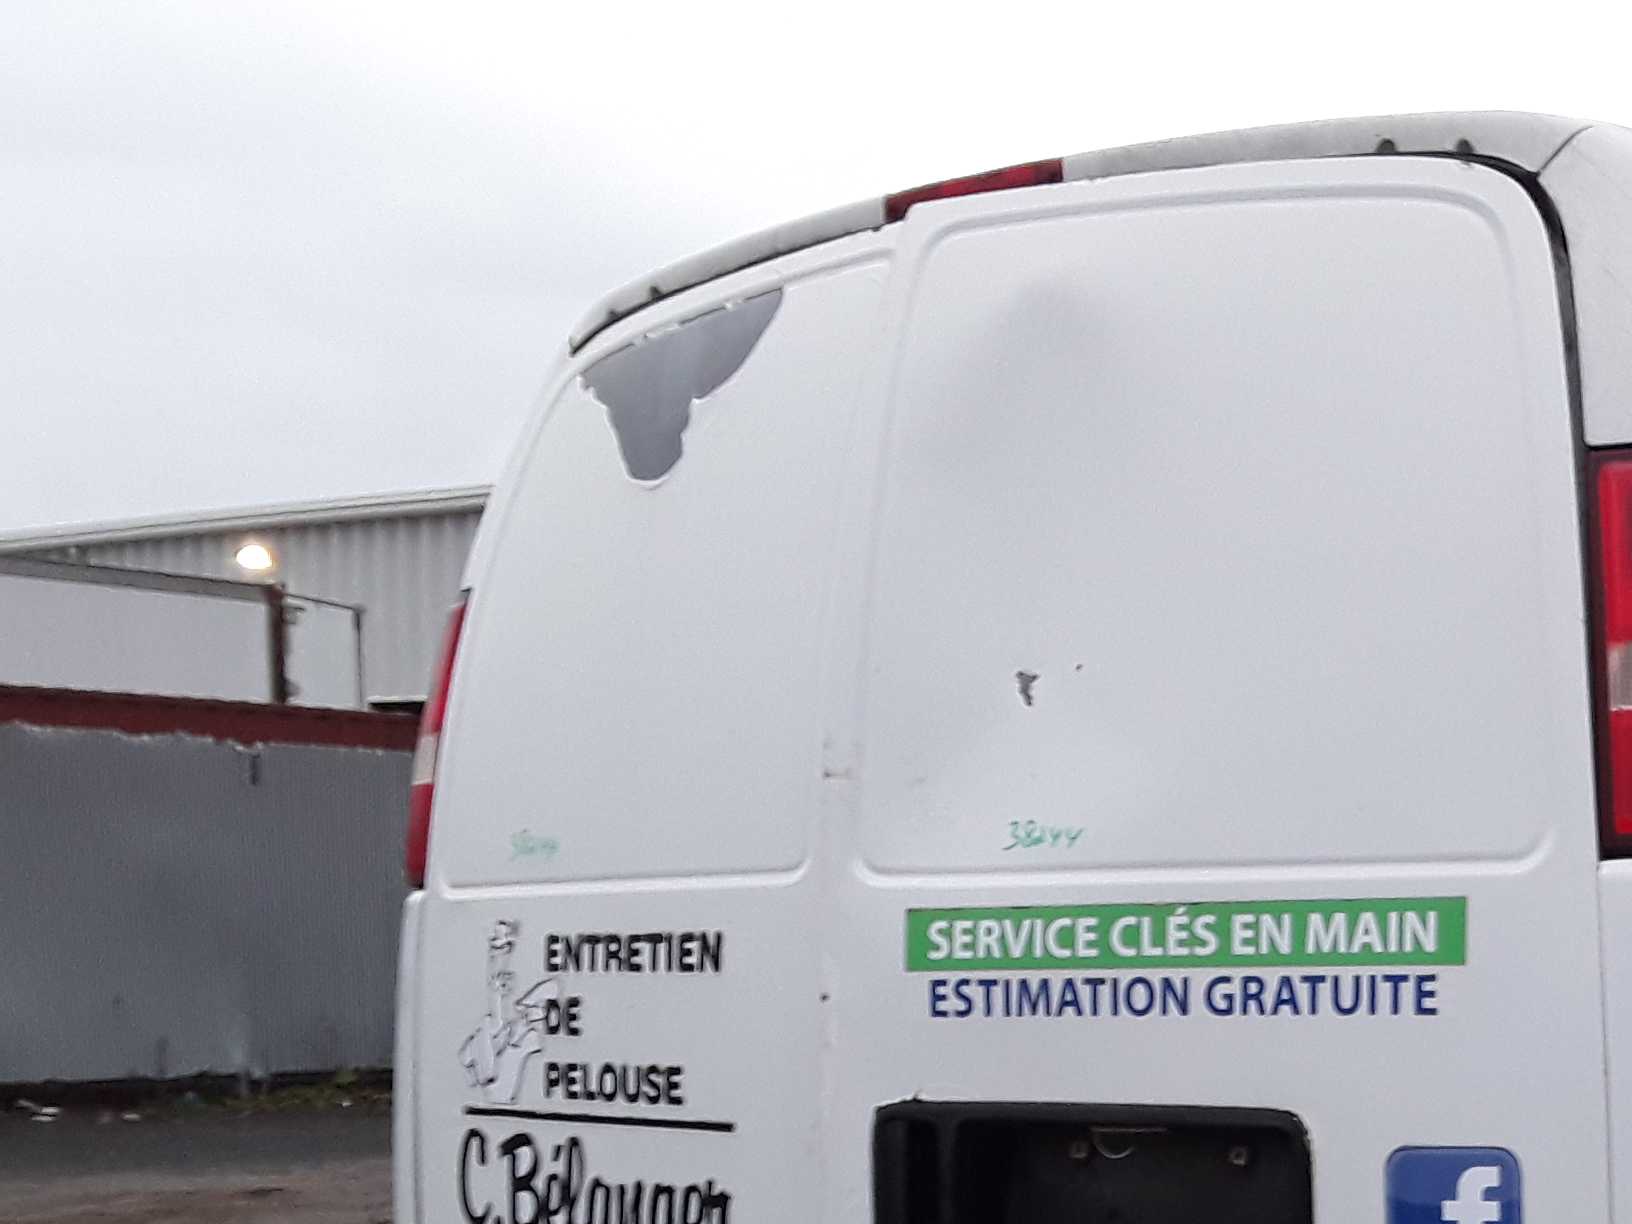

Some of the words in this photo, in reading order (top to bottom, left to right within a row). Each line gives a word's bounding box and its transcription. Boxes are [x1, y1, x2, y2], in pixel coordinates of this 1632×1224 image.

[544, 931, 723, 973] ENTRETIEN
[926, 916, 1099, 961] SERVICE
[1109, 907, 1219, 958] CLÉS
[1231, 913, 1291, 956] EN
[1304, 910, 1438, 954] MAIN
[546, 997, 582, 1036] DE
[929, 976, 1189, 1018] ESTIMATION
[1204, 973, 1438, 1016] GRATUITE
[544, 1063, 684, 1105] PELOUSE
